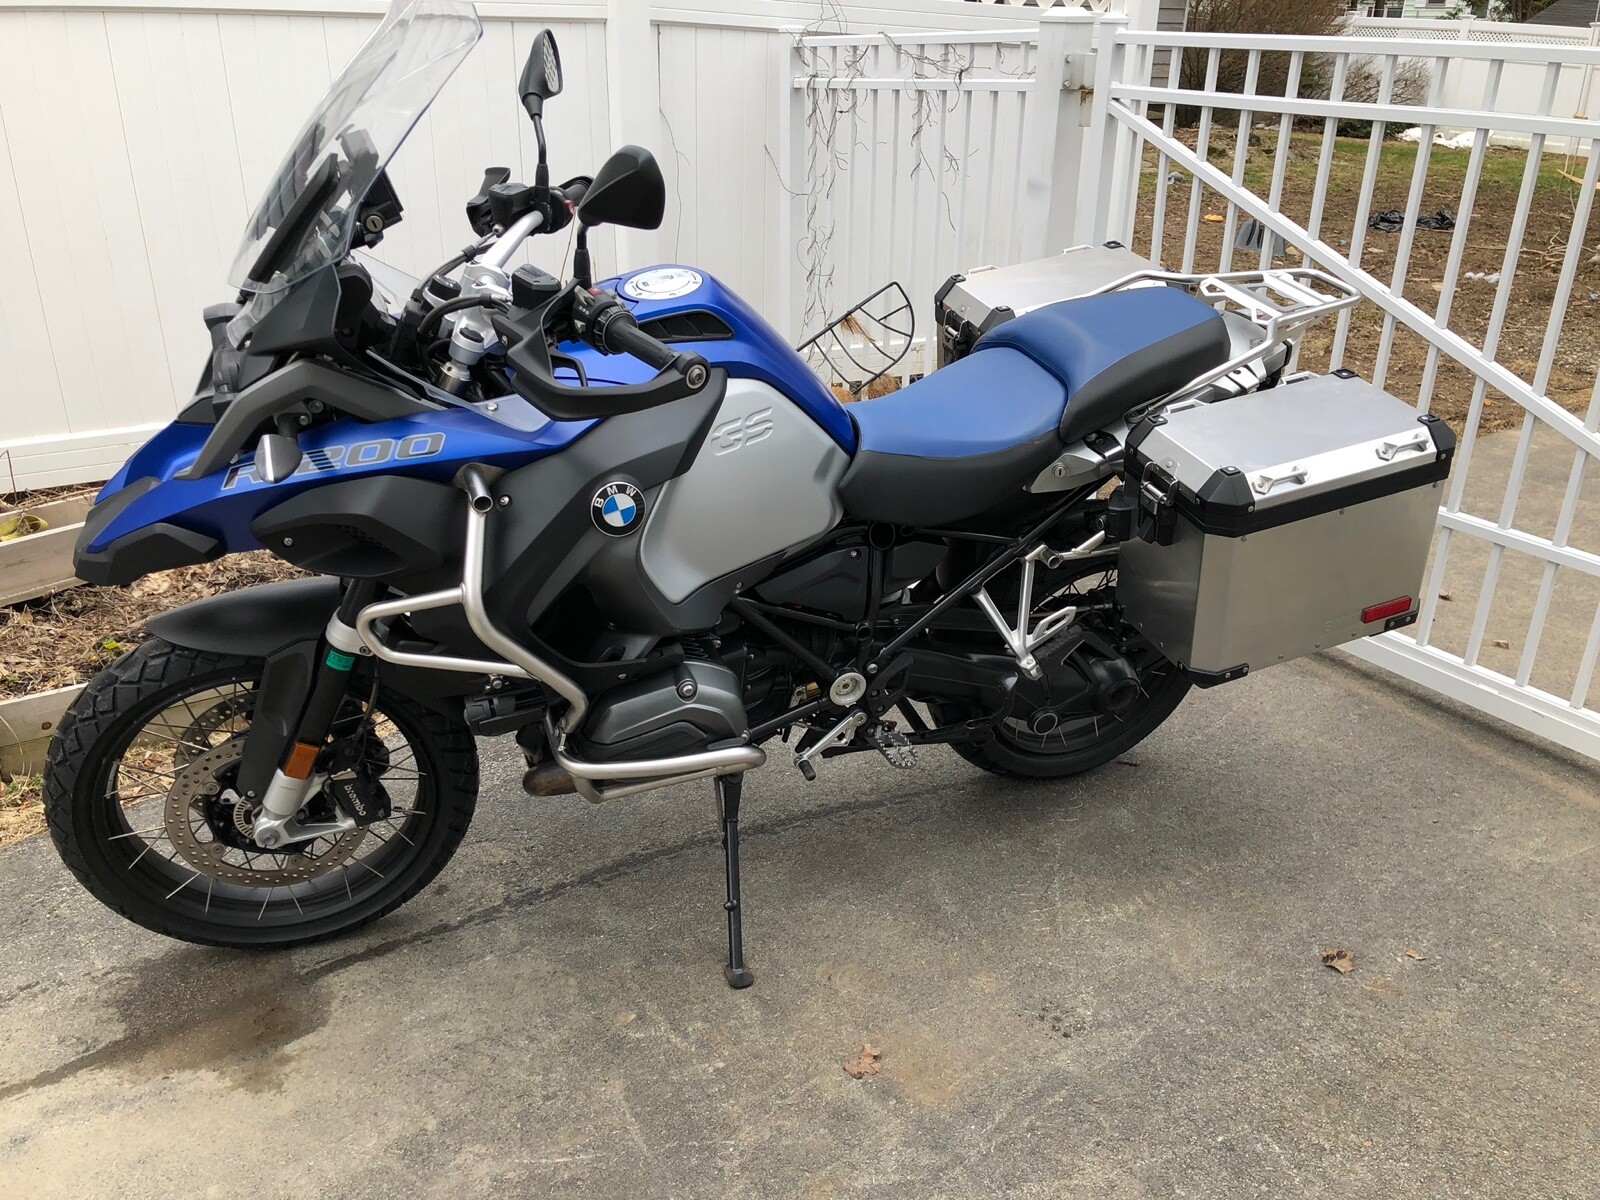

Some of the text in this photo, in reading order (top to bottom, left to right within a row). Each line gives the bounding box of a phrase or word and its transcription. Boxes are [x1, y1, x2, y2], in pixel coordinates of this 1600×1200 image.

[711, 407, 774, 456] GS
[221, 432, 446, 491] R200
[594, 485, 637, 508] BMW
[344, 783, 367, 816] brembo
